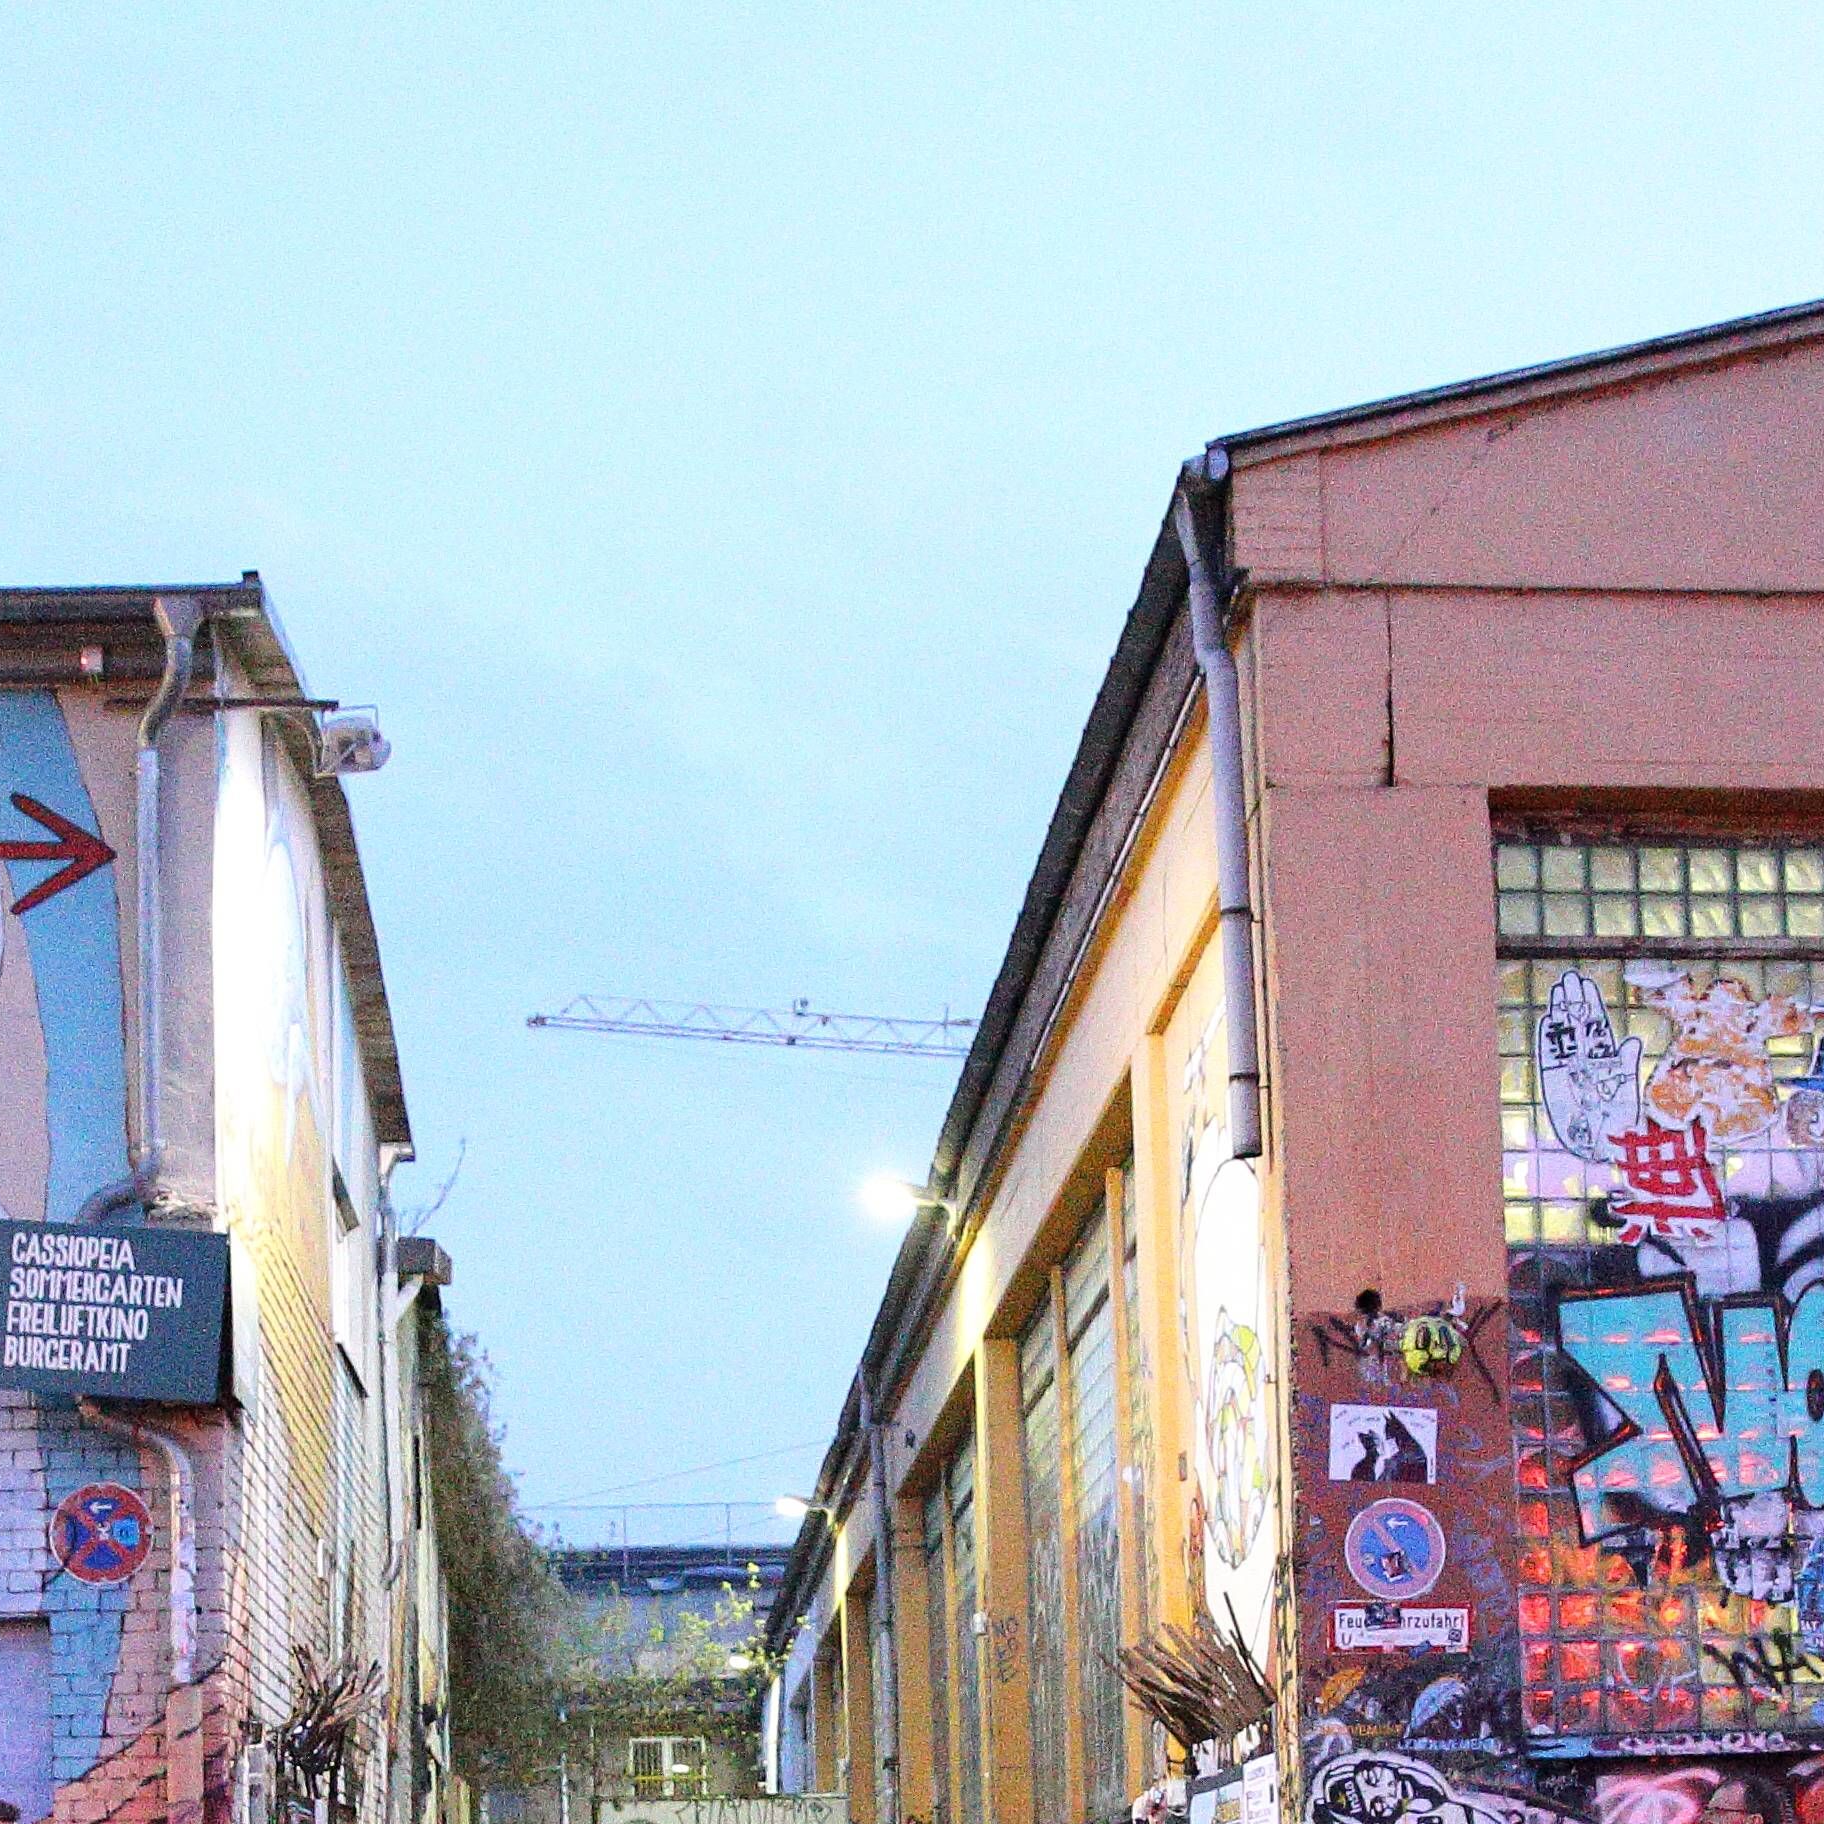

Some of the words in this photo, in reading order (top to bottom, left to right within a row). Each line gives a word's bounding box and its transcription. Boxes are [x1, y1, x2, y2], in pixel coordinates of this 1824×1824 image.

[11, 1232, 136, 1271] CASSIOPEIA
[9, 1267, 184, 1308] SOMMERGARTEN
[6, 1300, 149, 1341] FREILUFTKINO
[3, 1335, 132, 1373] BURGERAMT
[1339, 1612, 1465, 1630] Feuhrzufahrt
